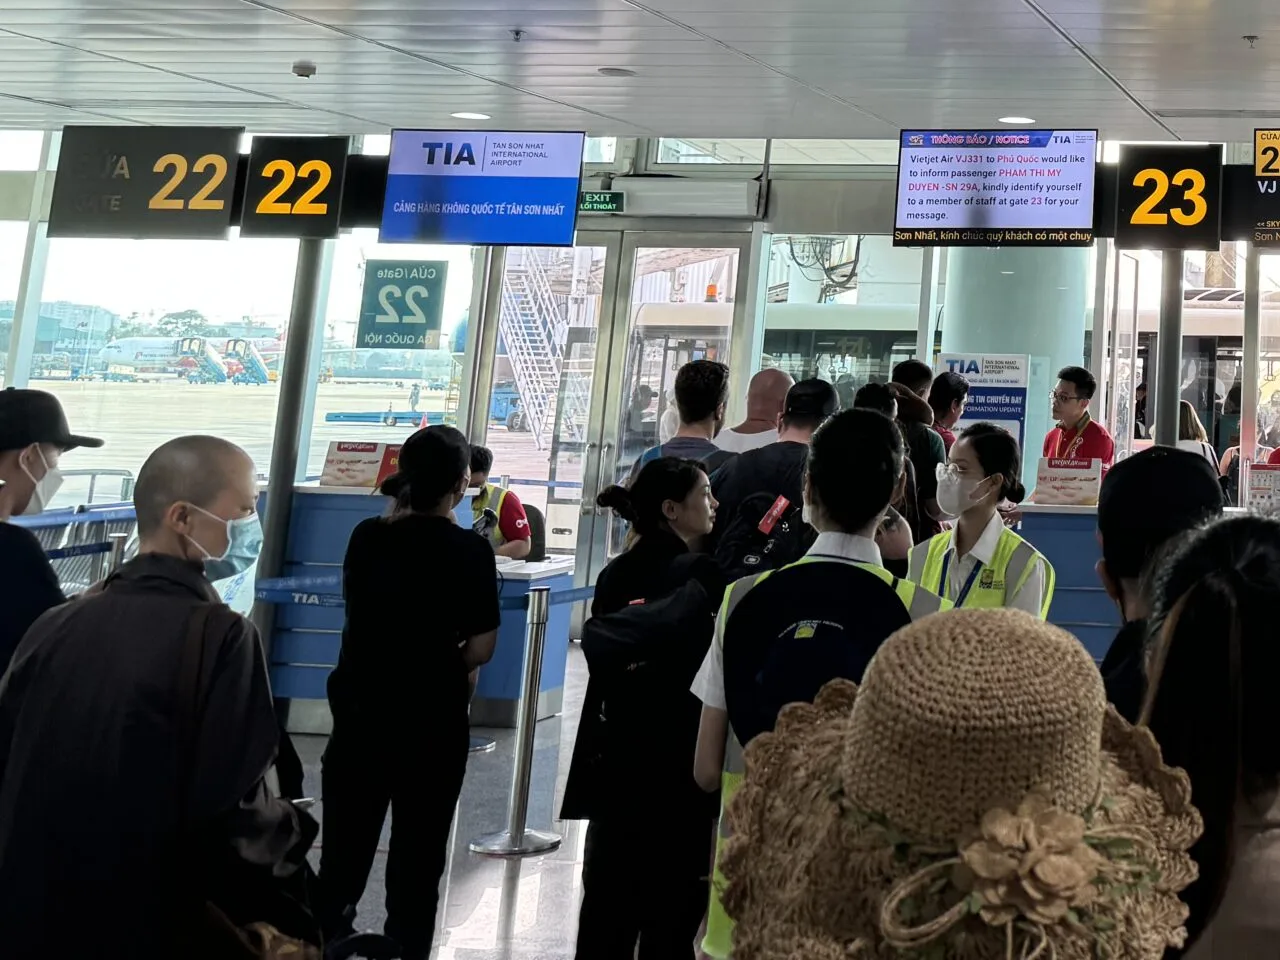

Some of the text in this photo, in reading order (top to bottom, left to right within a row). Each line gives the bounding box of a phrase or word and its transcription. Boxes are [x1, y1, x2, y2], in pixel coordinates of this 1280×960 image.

[931, 134, 964, 144] THÔNG
[966, 133, 987, 144] BÁO
[995, 135, 1030, 144] NOTICE
[1053, 136, 1071, 144] TIA
[422, 142, 476, 165] TIA
[910, 155, 938, 165] Vietjet
[940, 155, 954, 163] Air
[955, 155, 983, 163] VJ331
[1041, 155, 1067, 163] would
[1070, 155, 1085, 163] like
[909, 169, 918, 177] to
[920, 169, 949, 177] inform
[999, 169, 1026, 177] PHAM
[1030, 169, 1045, 177] THI
[1047, 169, 1062, 177] MY
[149, 153, 228, 210] 22
[256, 159, 332, 214] 22
[908, 183, 939, 191] DUYEN
[960, 183, 980, 192] 29A,
[983, 183, 1009, 192] kindly
[1011, 183, 1044, 192] identify
[1046, 183, 1082, 192] yourself
[1257, 180, 1277, 193] VJ
[907, 197, 916, 205] to
[926, 197, 962, 205] member
[964, 197, 974, 205] of
[975, 197, 996, 205] staff
[1009, 198, 1029, 207] gate
[1031, 197, 1042, 205] 23
[1044, 197, 1057, 205] for
[1059, 198, 1079, 207] your
[1130, 168, 1207, 226] 23
[393, 200, 416, 212] CẢNG
[417, 201, 440, 213] HÀNG
[441, 202, 469, 214] KHÔNG
[471, 202, 494, 215] QUỐC
[495, 202, 506, 214] TẾ
[507, 202, 522, 215] TÂN
[542, 203, 565, 215] NHẤT
[593, 202, 616, 210] THOÁT
[906, 212, 949, 221] message.
[940, 230, 960, 240] kính
[986, 231, 1004, 242] quý
[1005, 230, 1033, 240] khách
[1035, 231, 1047, 240] có
[1049, 231, 1067, 242] một
[945, 359, 980, 374] TIA
[291, 593, 319, 605] TIA
